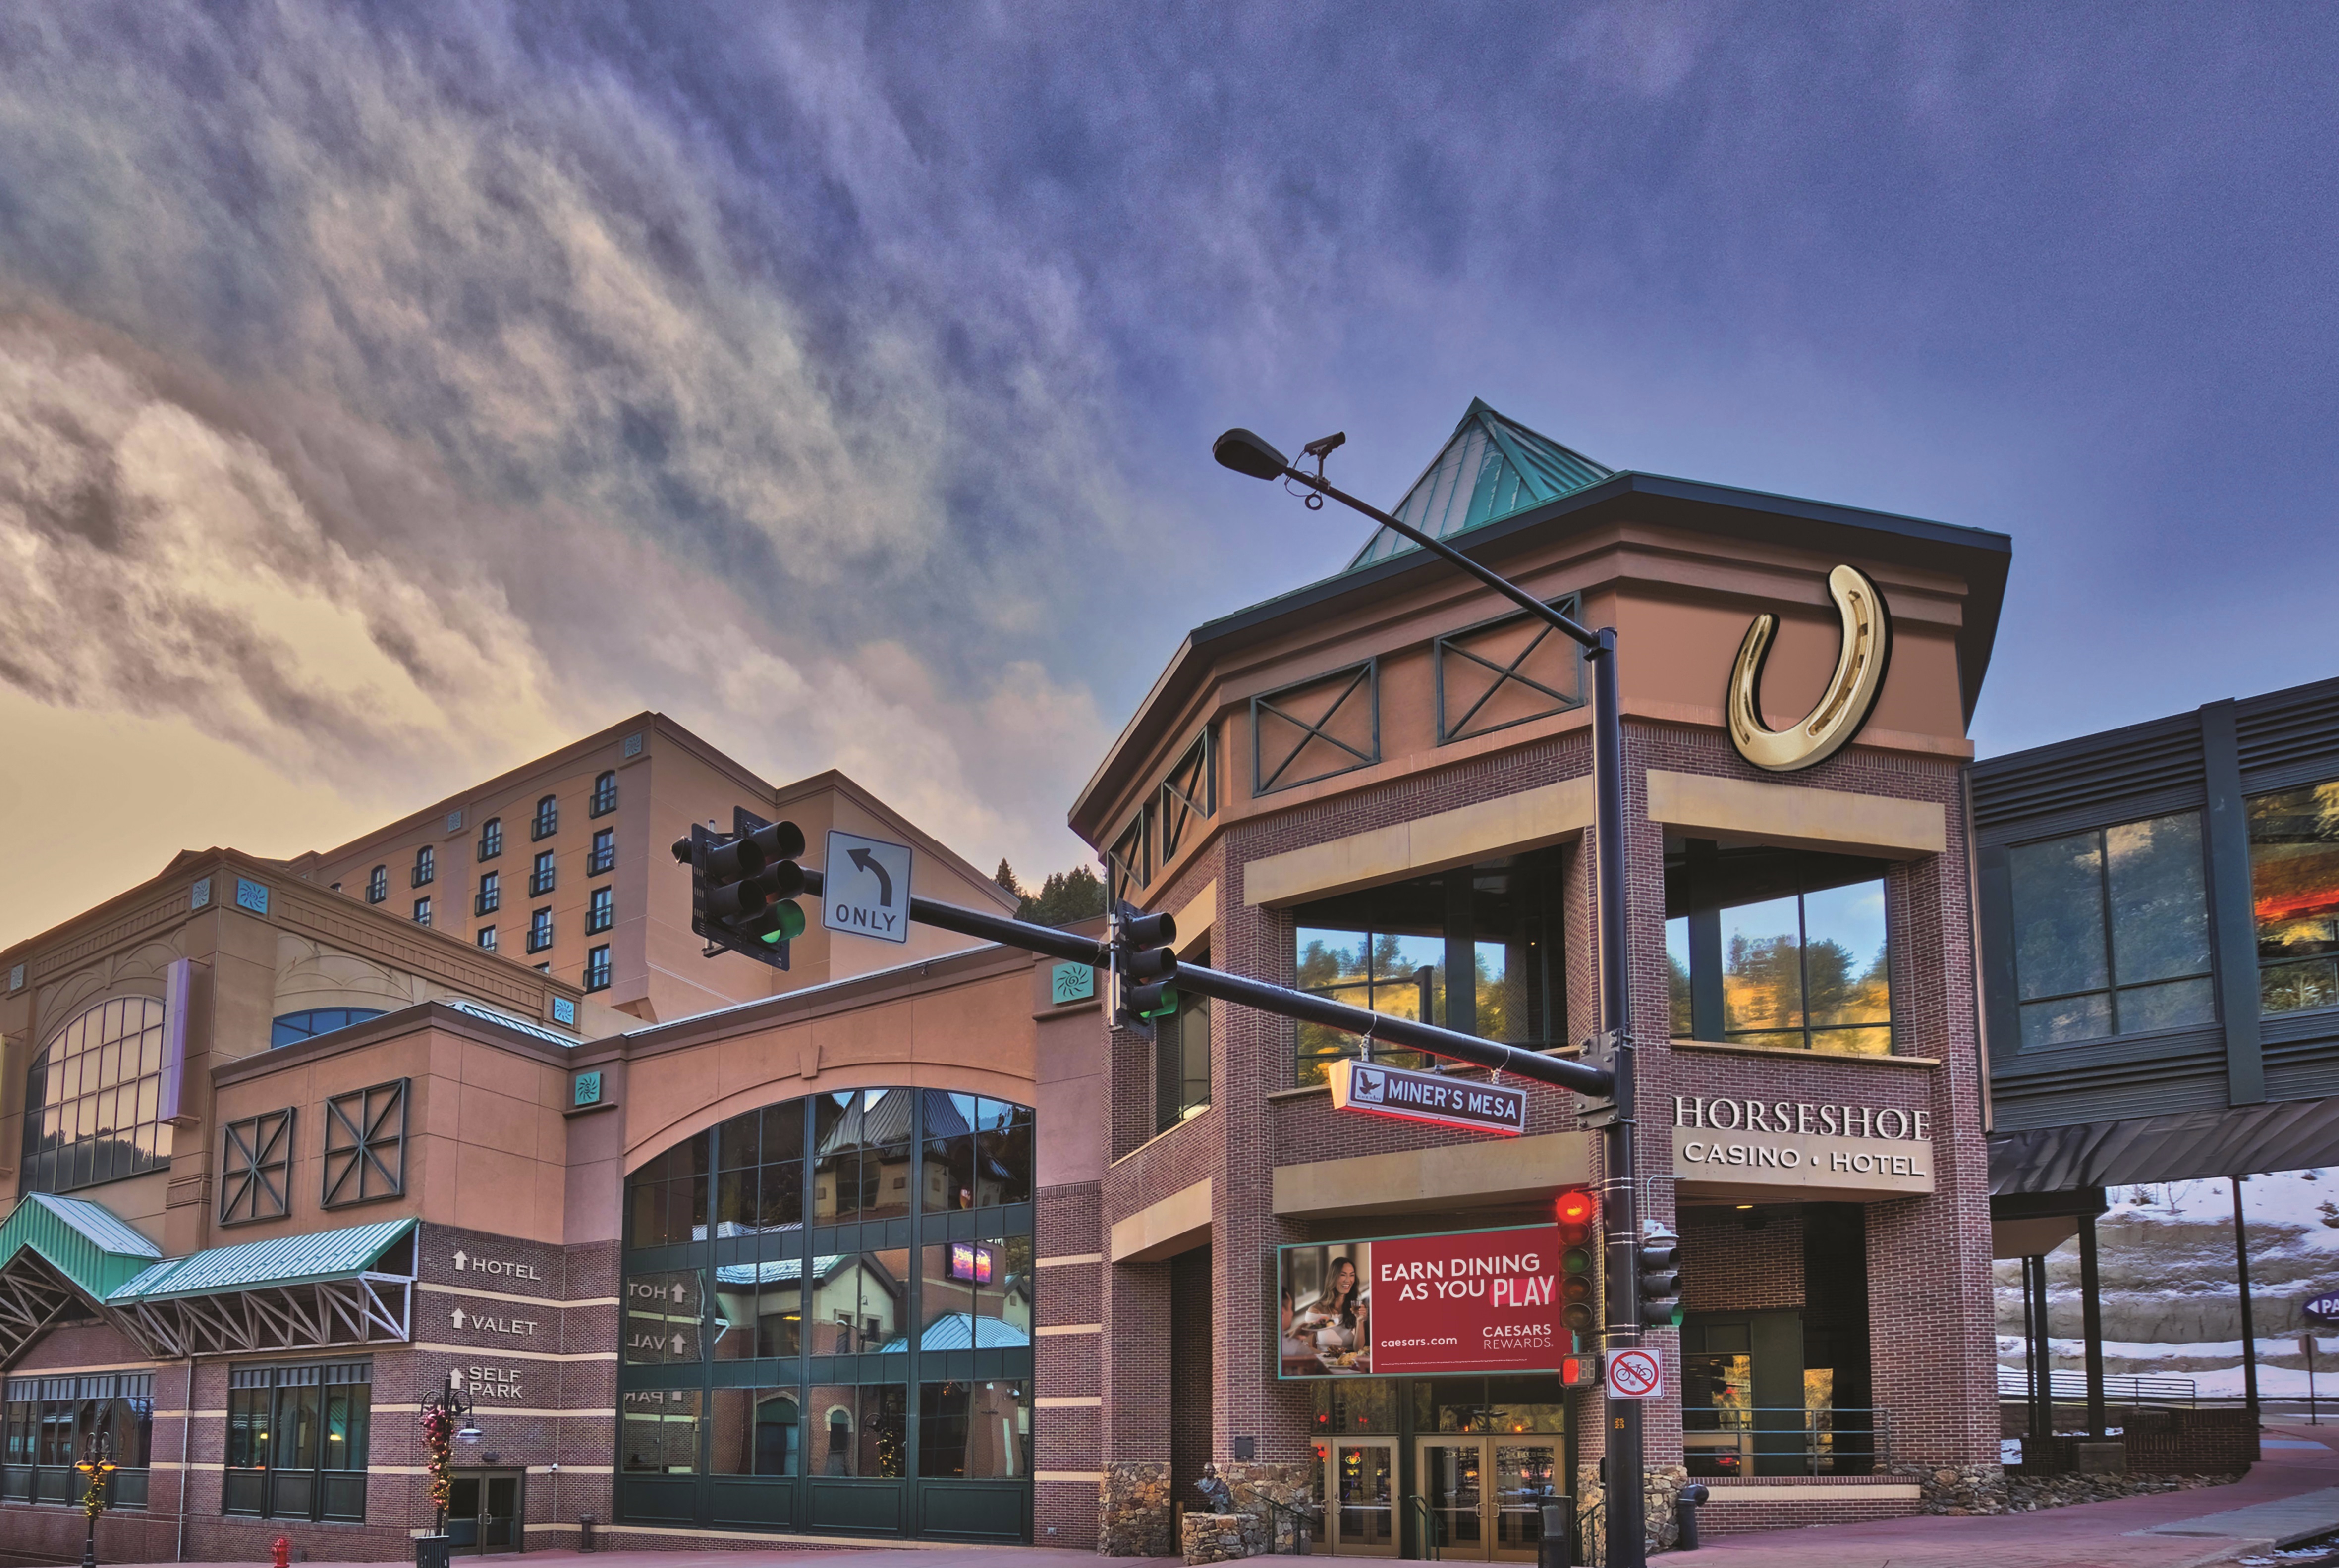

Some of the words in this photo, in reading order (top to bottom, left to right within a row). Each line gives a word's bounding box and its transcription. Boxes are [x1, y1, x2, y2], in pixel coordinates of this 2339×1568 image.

[836, 904, 896, 932] ONLY
[1388, 1079, 1463, 1110] MINER'S
[1468, 1092, 1516, 1120] MESA
[1674, 1096, 1931, 1141] HORSESHOE
[1684, 1142, 1800, 1167] CASINO
[1832, 1151, 1926, 1176] HOTEL
[472, 1258, 541, 1281] HOTEL
[1382, 1260, 1443, 1282] EARN
[1451, 1253, 1540, 1277] DINING
[1399, 1283, 1428, 1301] AS
[1434, 1279, 1485, 1298] YOU
[1494, 1275, 1555, 1307] PLAY
[471, 1315, 538, 1335] VALET
[1483, 1324, 1552, 1338] CAESARS
[1381, 1337, 1457, 1347] caesars.com
[469, 1366, 521, 1383] SELF
[469, 1382, 522, 1399] PARK
